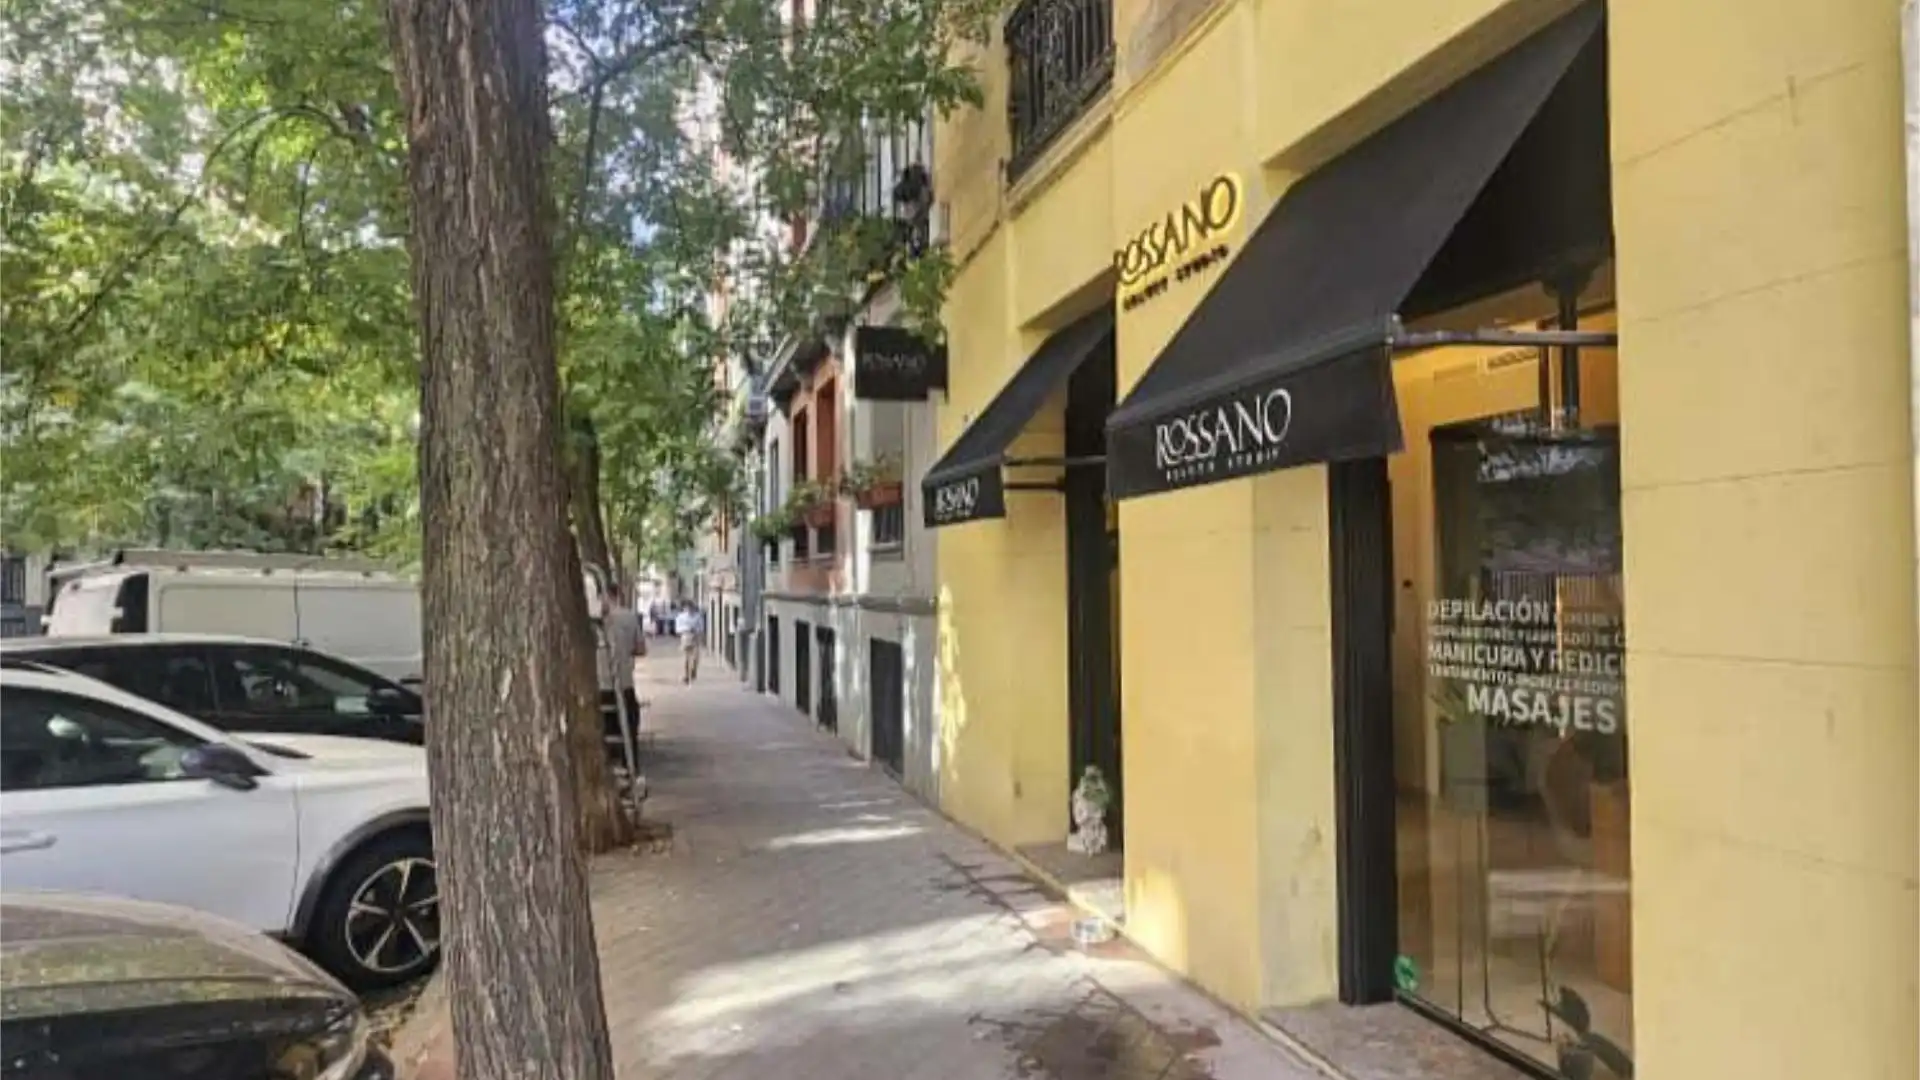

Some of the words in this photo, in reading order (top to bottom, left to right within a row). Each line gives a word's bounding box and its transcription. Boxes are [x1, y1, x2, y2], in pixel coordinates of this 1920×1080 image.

[1113, 176, 1237, 285] ROSSANO
[1156, 388, 1292, 469] ROSSANO
[1429, 594, 1549, 624] DEPILACIÓN
[1428, 642, 1527, 670] MANICURA
[1529, 647, 1545, 671] Y
[1466, 684, 1617, 735] MASAJES
